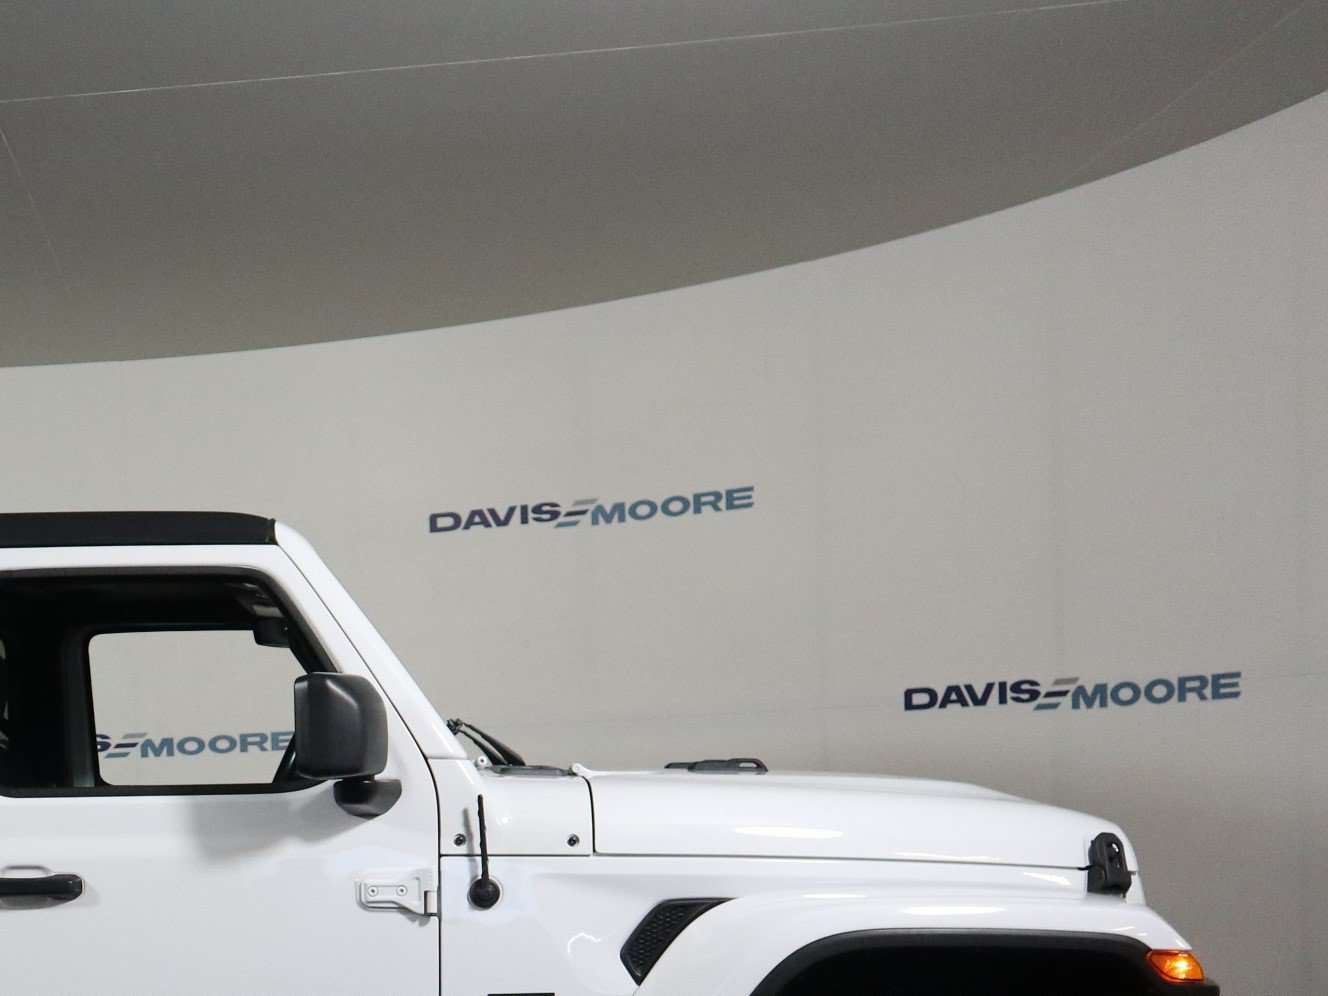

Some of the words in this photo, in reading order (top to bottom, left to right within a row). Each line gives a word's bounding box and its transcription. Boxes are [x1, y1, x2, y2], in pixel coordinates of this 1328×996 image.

[429, 502, 561, 533] DAVIS
[590, 486, 755, 525] MOORE
[904, 679, 1042, 711] DAVIS
[1071, 671, 1242, 710] MOORE
[140, 731, 295, 758] MOORE
